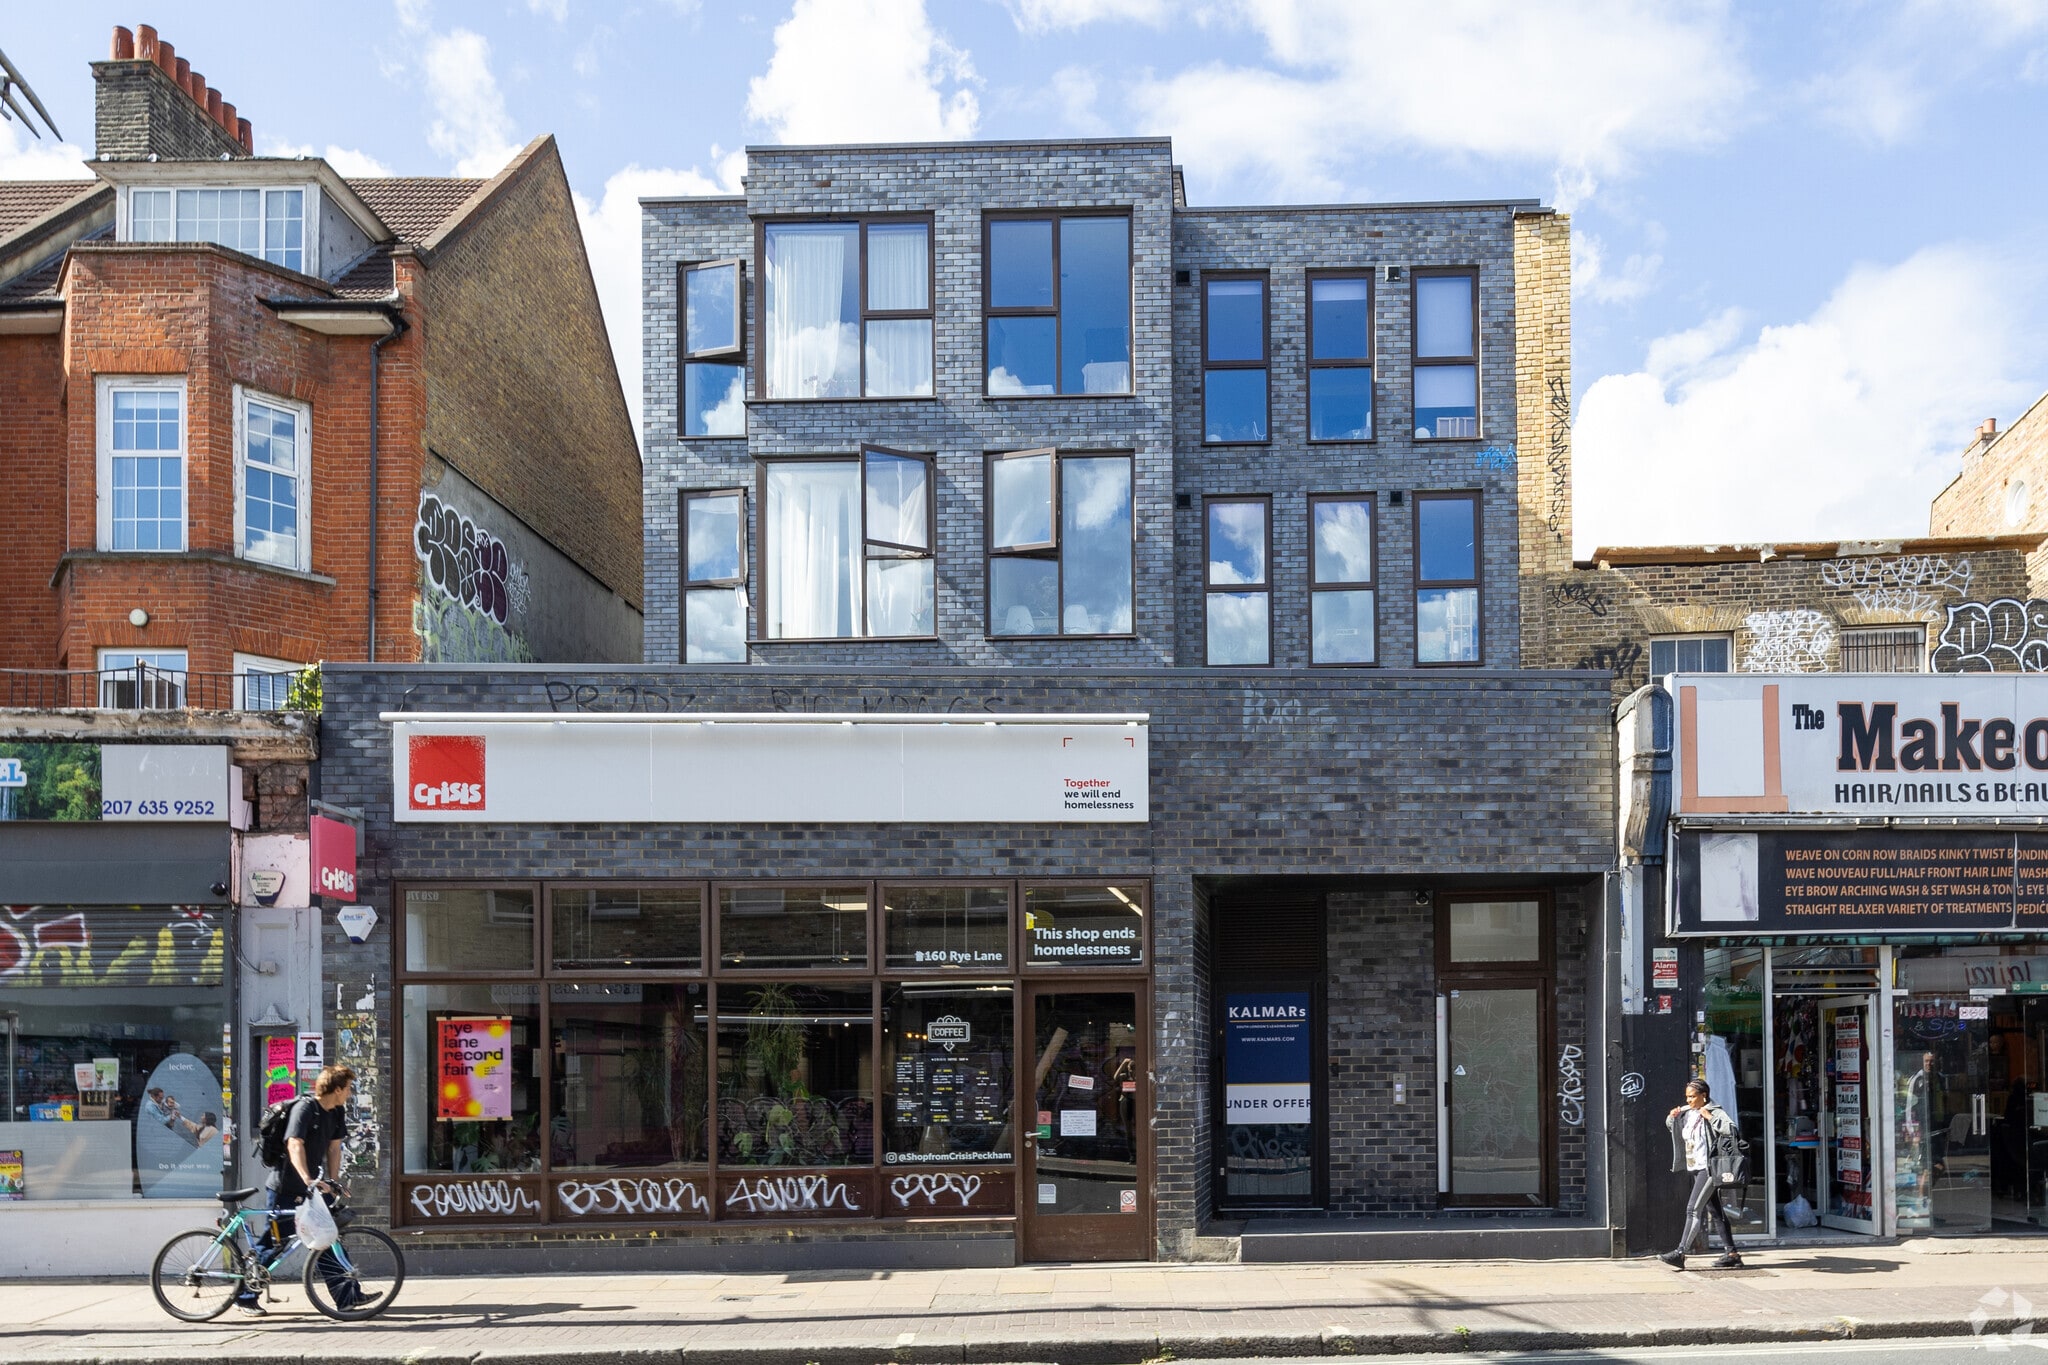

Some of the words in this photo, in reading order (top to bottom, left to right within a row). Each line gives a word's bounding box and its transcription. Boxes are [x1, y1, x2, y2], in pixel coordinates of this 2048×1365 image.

[1792, 704, 1825, 730] The
[1836, 701, 2048, 773] Makeo
[1064, 778, 1111, 789] Together
[1081, 789, 1100, 798] will
[1101, 789, 1121, 798] end
[103, 800, 132, 815] 207
[138, 800, 168, 815] 635
[173, 800, 214, 815] 9252
[1064, 800, 1134, 809] homelessness
[1785, 849, 1821, 861] WEAVE
[1824, 849, 1840, 860] ON
[1842, 849, 1870, 860] CORN
[1873, 849, 1897, 860] ROW
[1900, 849, 1936, 860] BRAIDS
[1939, 849, 1971, 860] KINKY
[1973, 848, 2005, 860] TWIST
[1785, 867, 1815, 879] WAVE
[1817, 867, 1868, 879] NOUVEAU
[1870, 867, 1926, 878] FULL/HALF
[1928, 867, 1961, 878] FRONT
[1963, 866, 1988, 878] HAIR
[1991, 866, 2014, 877] LINE
[2019, 867, 2048, 879] WASH
[1785, 885, 1804, 897] EYE
[1806, 885, 1838, 897] BROW
[1840, 885, 1887, 896] ARCHING
[1889, 885, 1919, 896] WASH
[1921, 885, 1929, 896] &
[1931, 884, 1948, 896] SET
[1950, 884, 1980, 895] WASH
[1983, 884, 1991, 895] &
[2027, 884, 2045, 895] EYE
[1785, 904, 1837, 915] STRAIGHT
[1839, 903, 1884, 915] RELAXER
[1886, 903, 1929, 914] VARIETY
[1931, 903, 1944, 914] OF
[1946, 902, 2012, 914] TREATMENTS
[2016, 903, 2048, 914] PEDIC
[1034, 927, 1063, 940] This
[1066, 927, 1100, 942] shop
[1102, 927, 1136, 939] ends
[1034, 943, 1131, 956] homelessness
[925, 951, 946, 961] 160
[950, 951, 971, 964] Rye
[974, 951, 1003, 961] Lane
[1229, 1006, 1306, 1018] KALMARs
[444, 1023, 473, 1037] rye
[934, 1027, 964, 1037] COFFEE
[444, 1036, 478, 1048] lane
[444, 1048, 504, 1061] record
[444, 1063, 474, 1076] fair
[1225, 1099, 1268, 1109] UNDER
[1838, 1094, 1858, 1105] TAILOR
[898, 1151, 1012, 1163] @ShopfromCrisisPeckham
